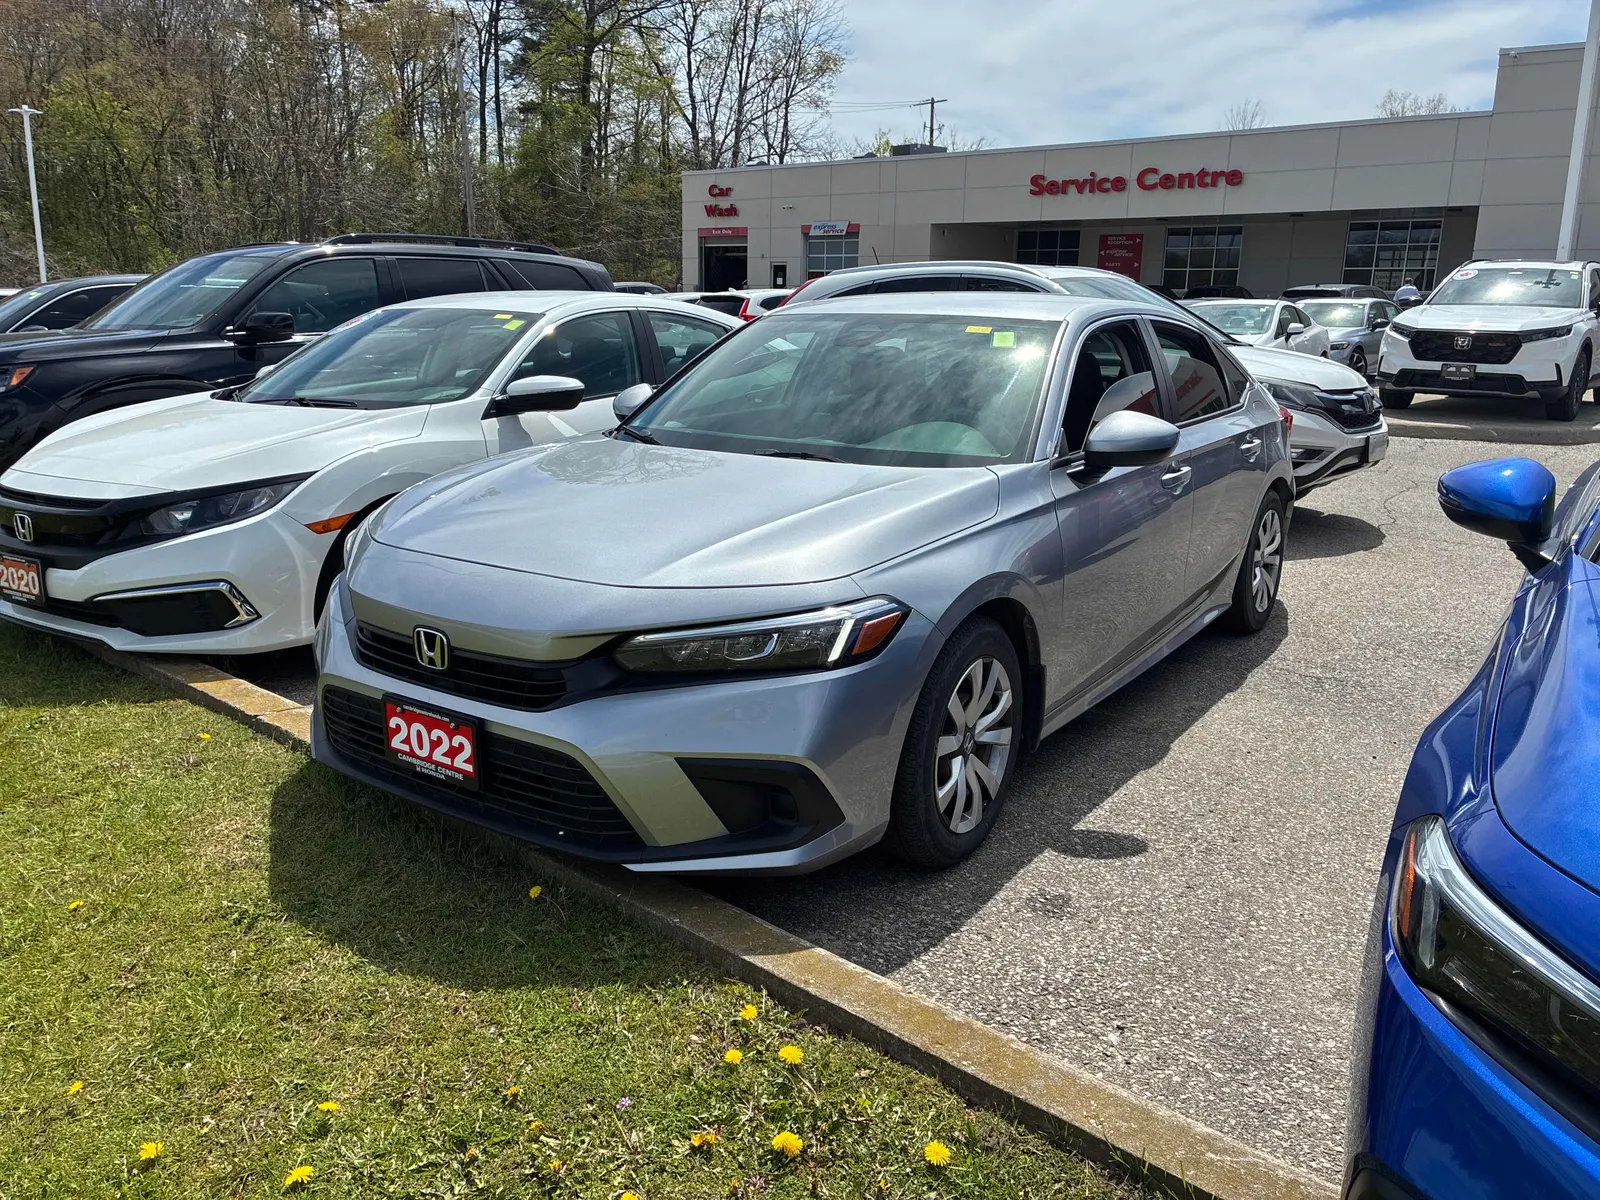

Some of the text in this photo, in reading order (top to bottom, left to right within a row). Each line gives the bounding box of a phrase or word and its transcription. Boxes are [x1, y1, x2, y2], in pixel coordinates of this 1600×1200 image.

[708, 184, 733, 197] Car
[1029, 167, 1243, 196] Service Centre
[704, 204, 739, 217] Wash
[0, 565, 39, 594] 2020
[389, 716, 473, 773] 2022
[398, 753, 464, 780] CAMBRIDGE CENTRE
[422, 766, 446, 780] HONDA
